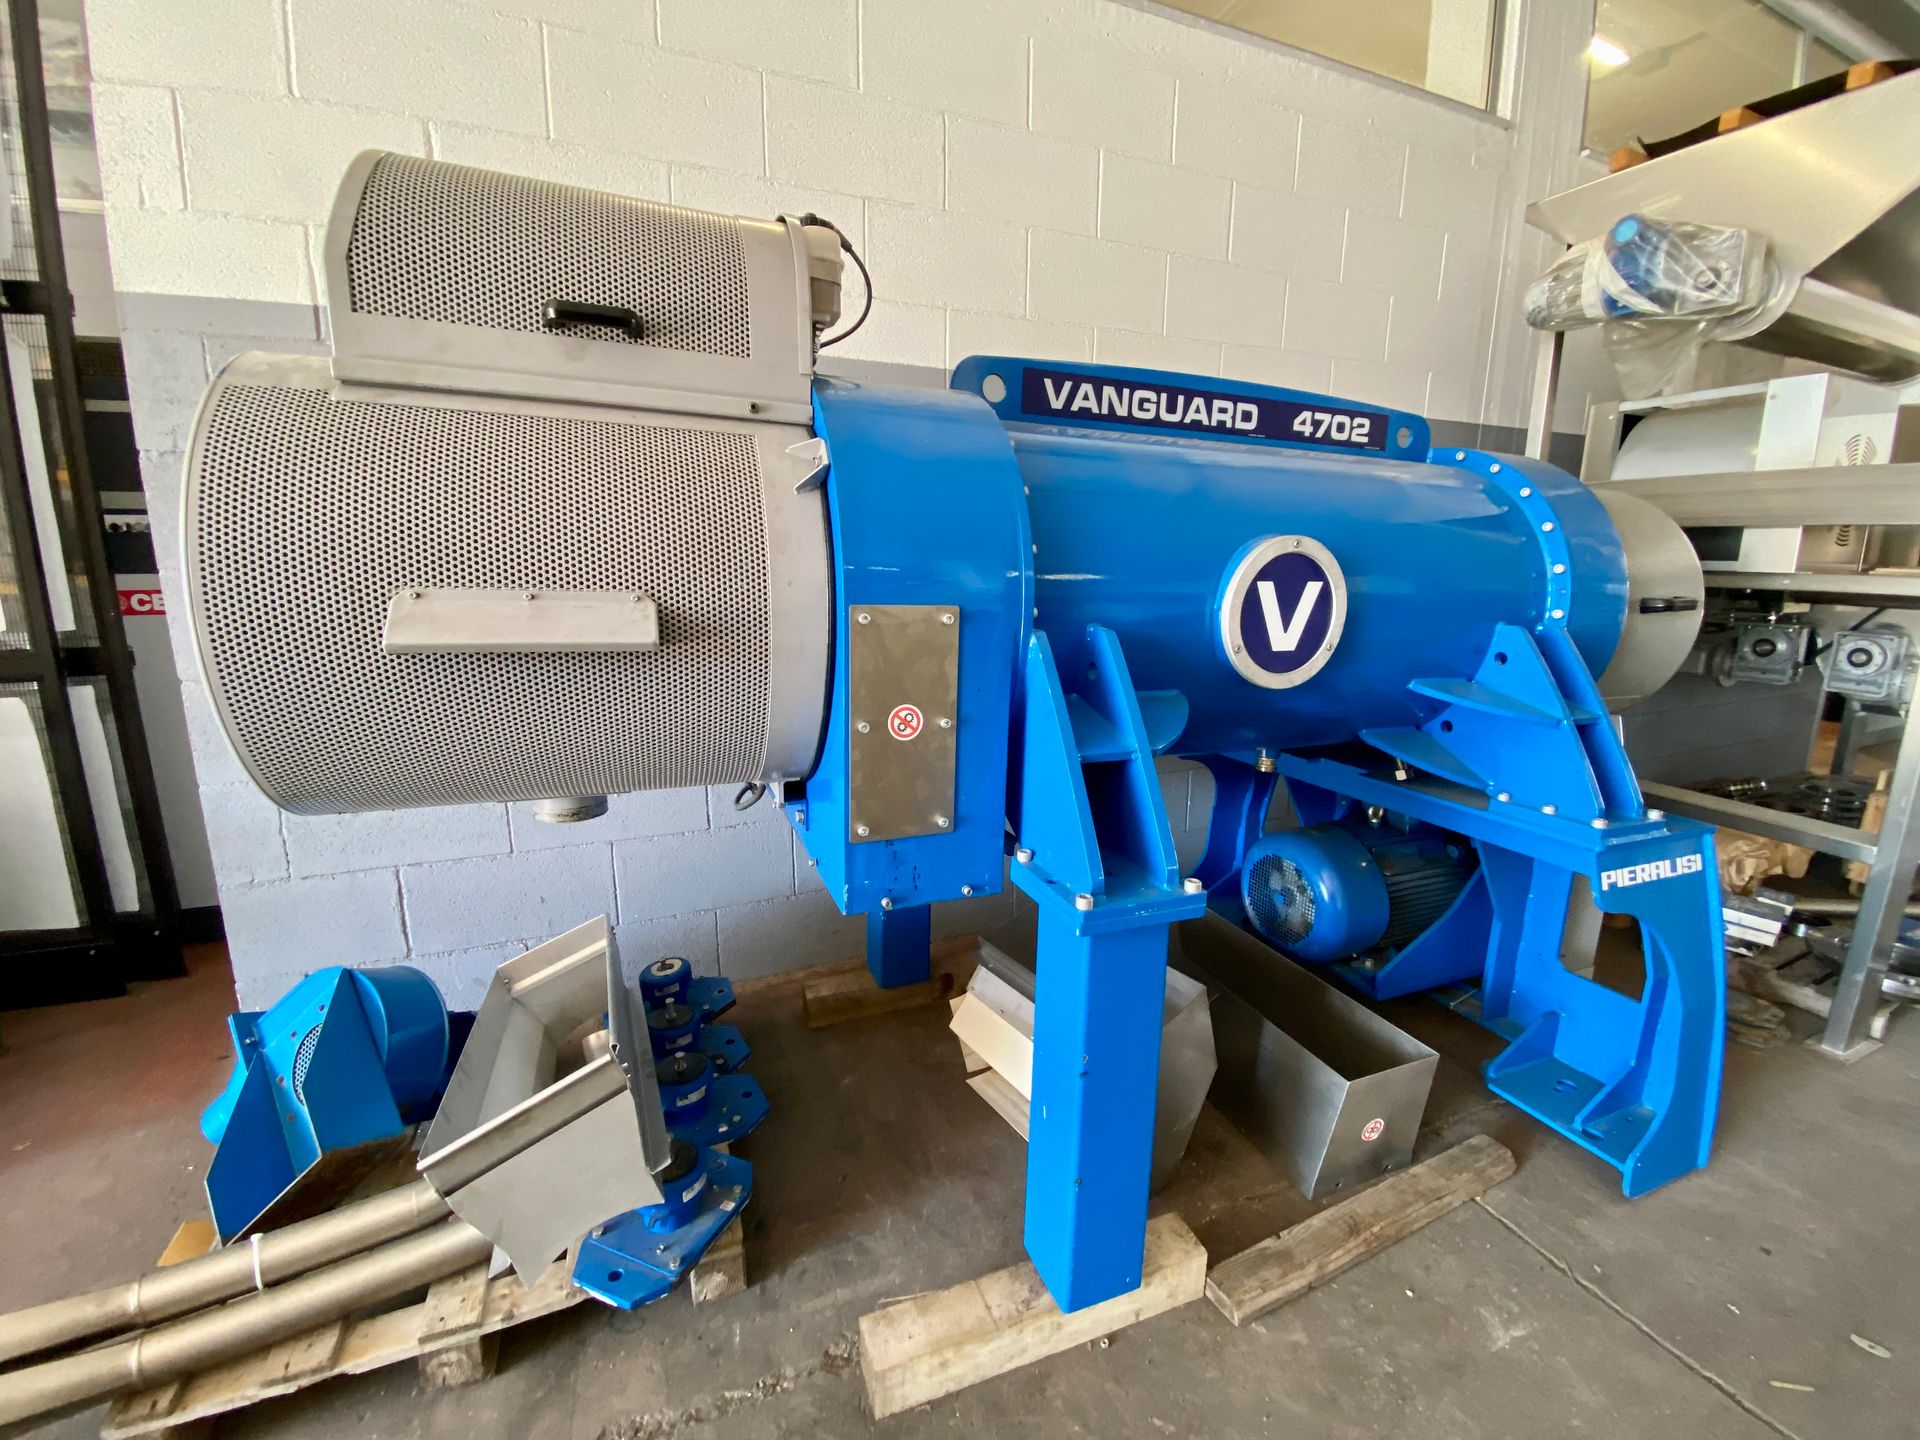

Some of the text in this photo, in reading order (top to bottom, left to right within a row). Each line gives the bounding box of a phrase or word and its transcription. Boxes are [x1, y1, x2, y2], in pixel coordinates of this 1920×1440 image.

[1043, 377, 1371, 444] VANGUARD 4702
[1256, 581, 1324, 652] V
[1600, 853, 1703, 891] PIERALISI
